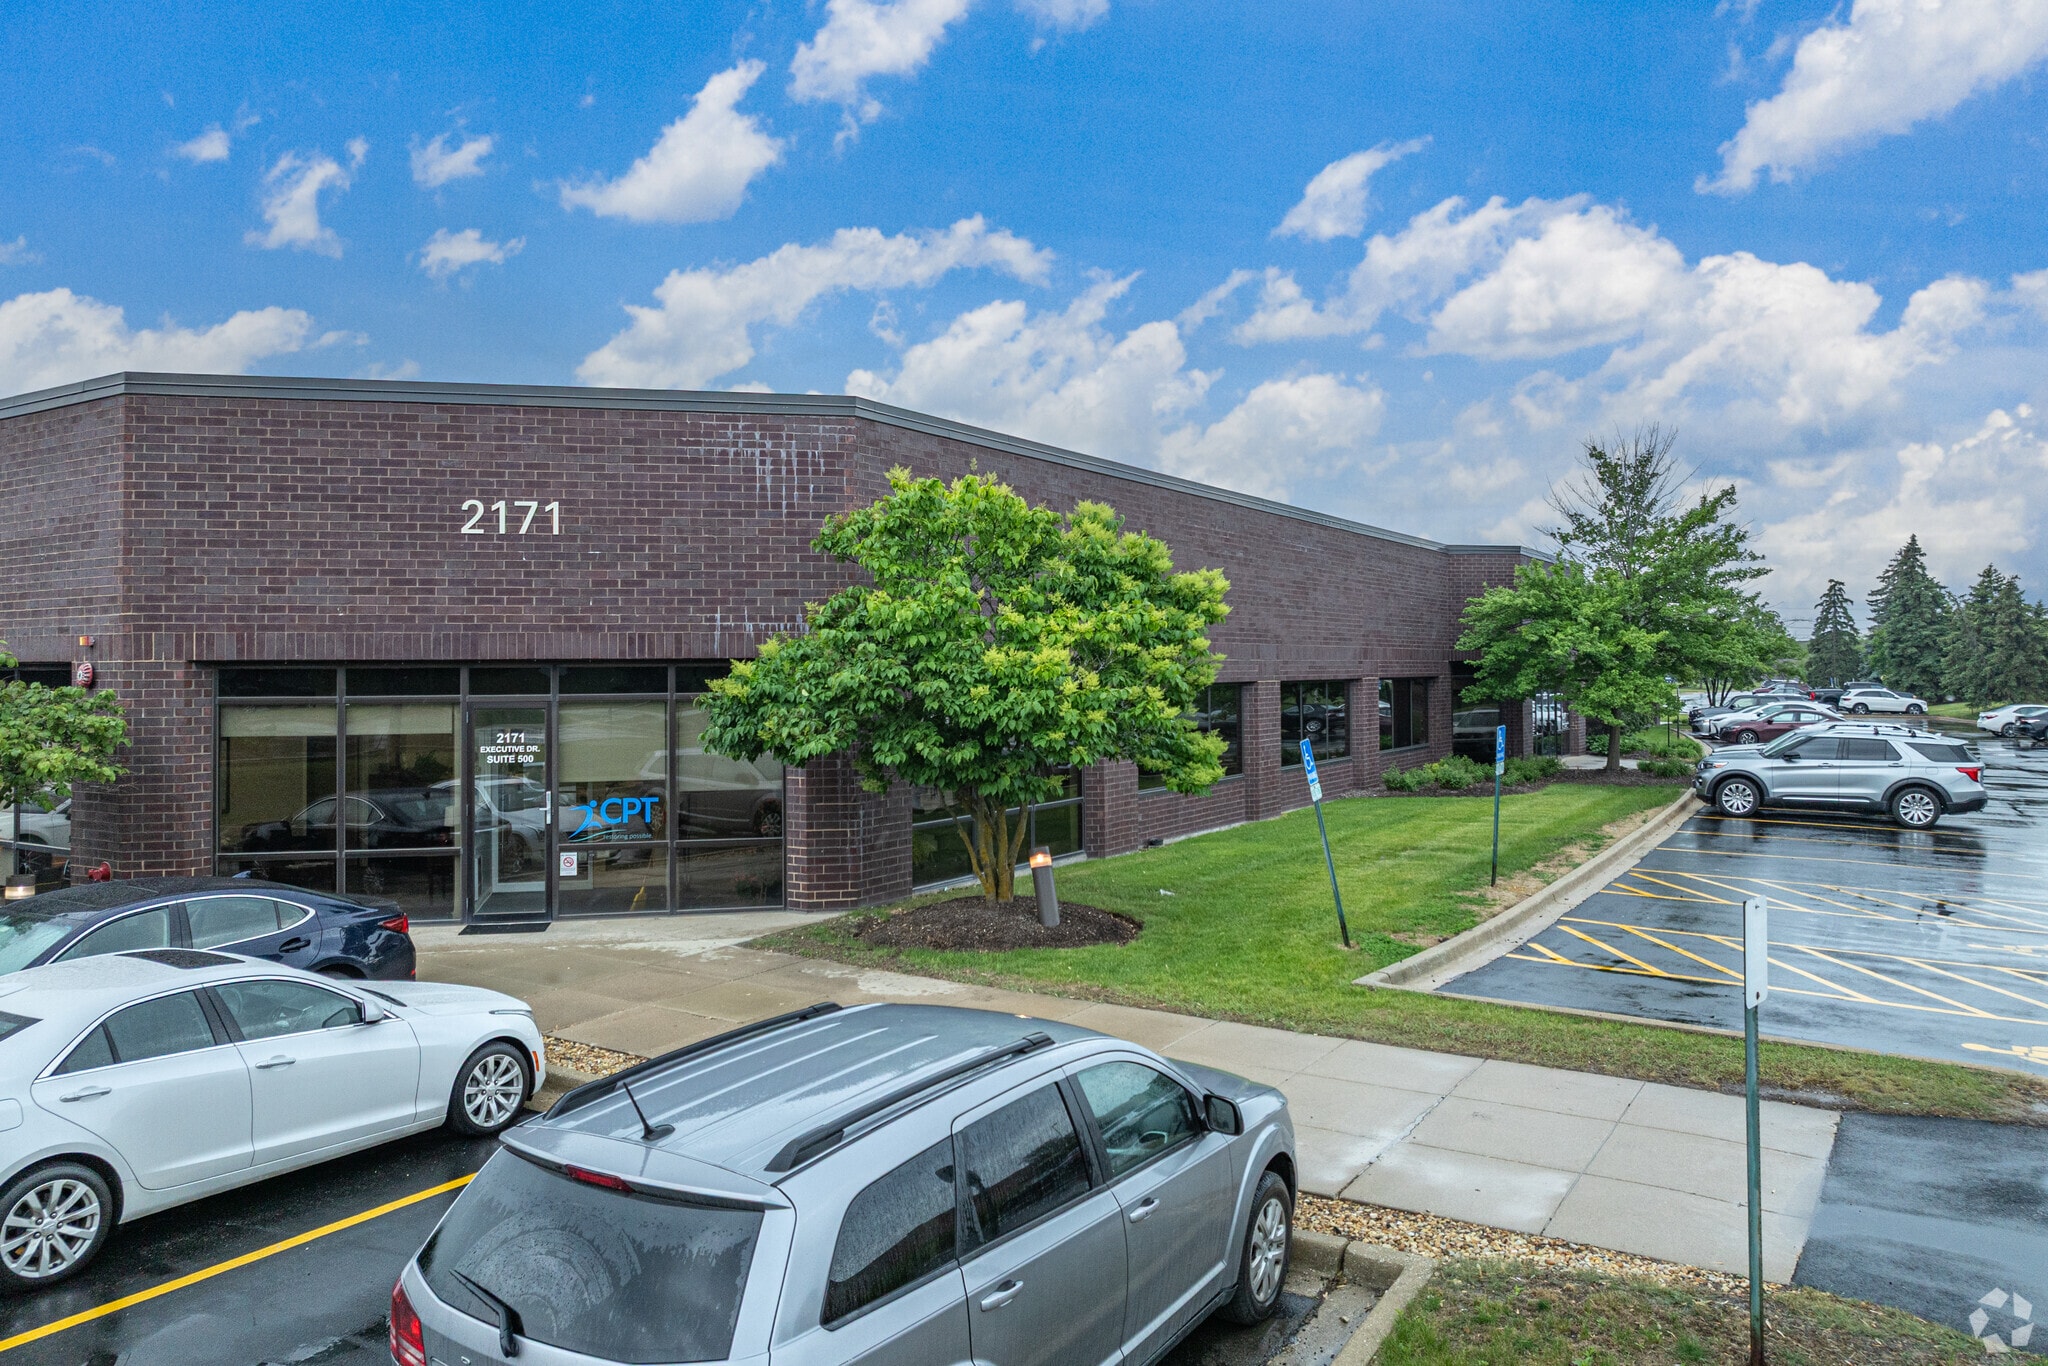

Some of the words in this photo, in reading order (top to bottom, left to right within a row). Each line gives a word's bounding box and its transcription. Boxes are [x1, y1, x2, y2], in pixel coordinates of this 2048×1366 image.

[460, 499, 560, 536] 2171
[496, 732, 525, 744] 2171
[480, 745, 525, 753] EXECUTIVE
[486, 755, 516, 764] SUITE
[517, 755, 535, 763] 500
[600, 796, 659, 825] CPT
